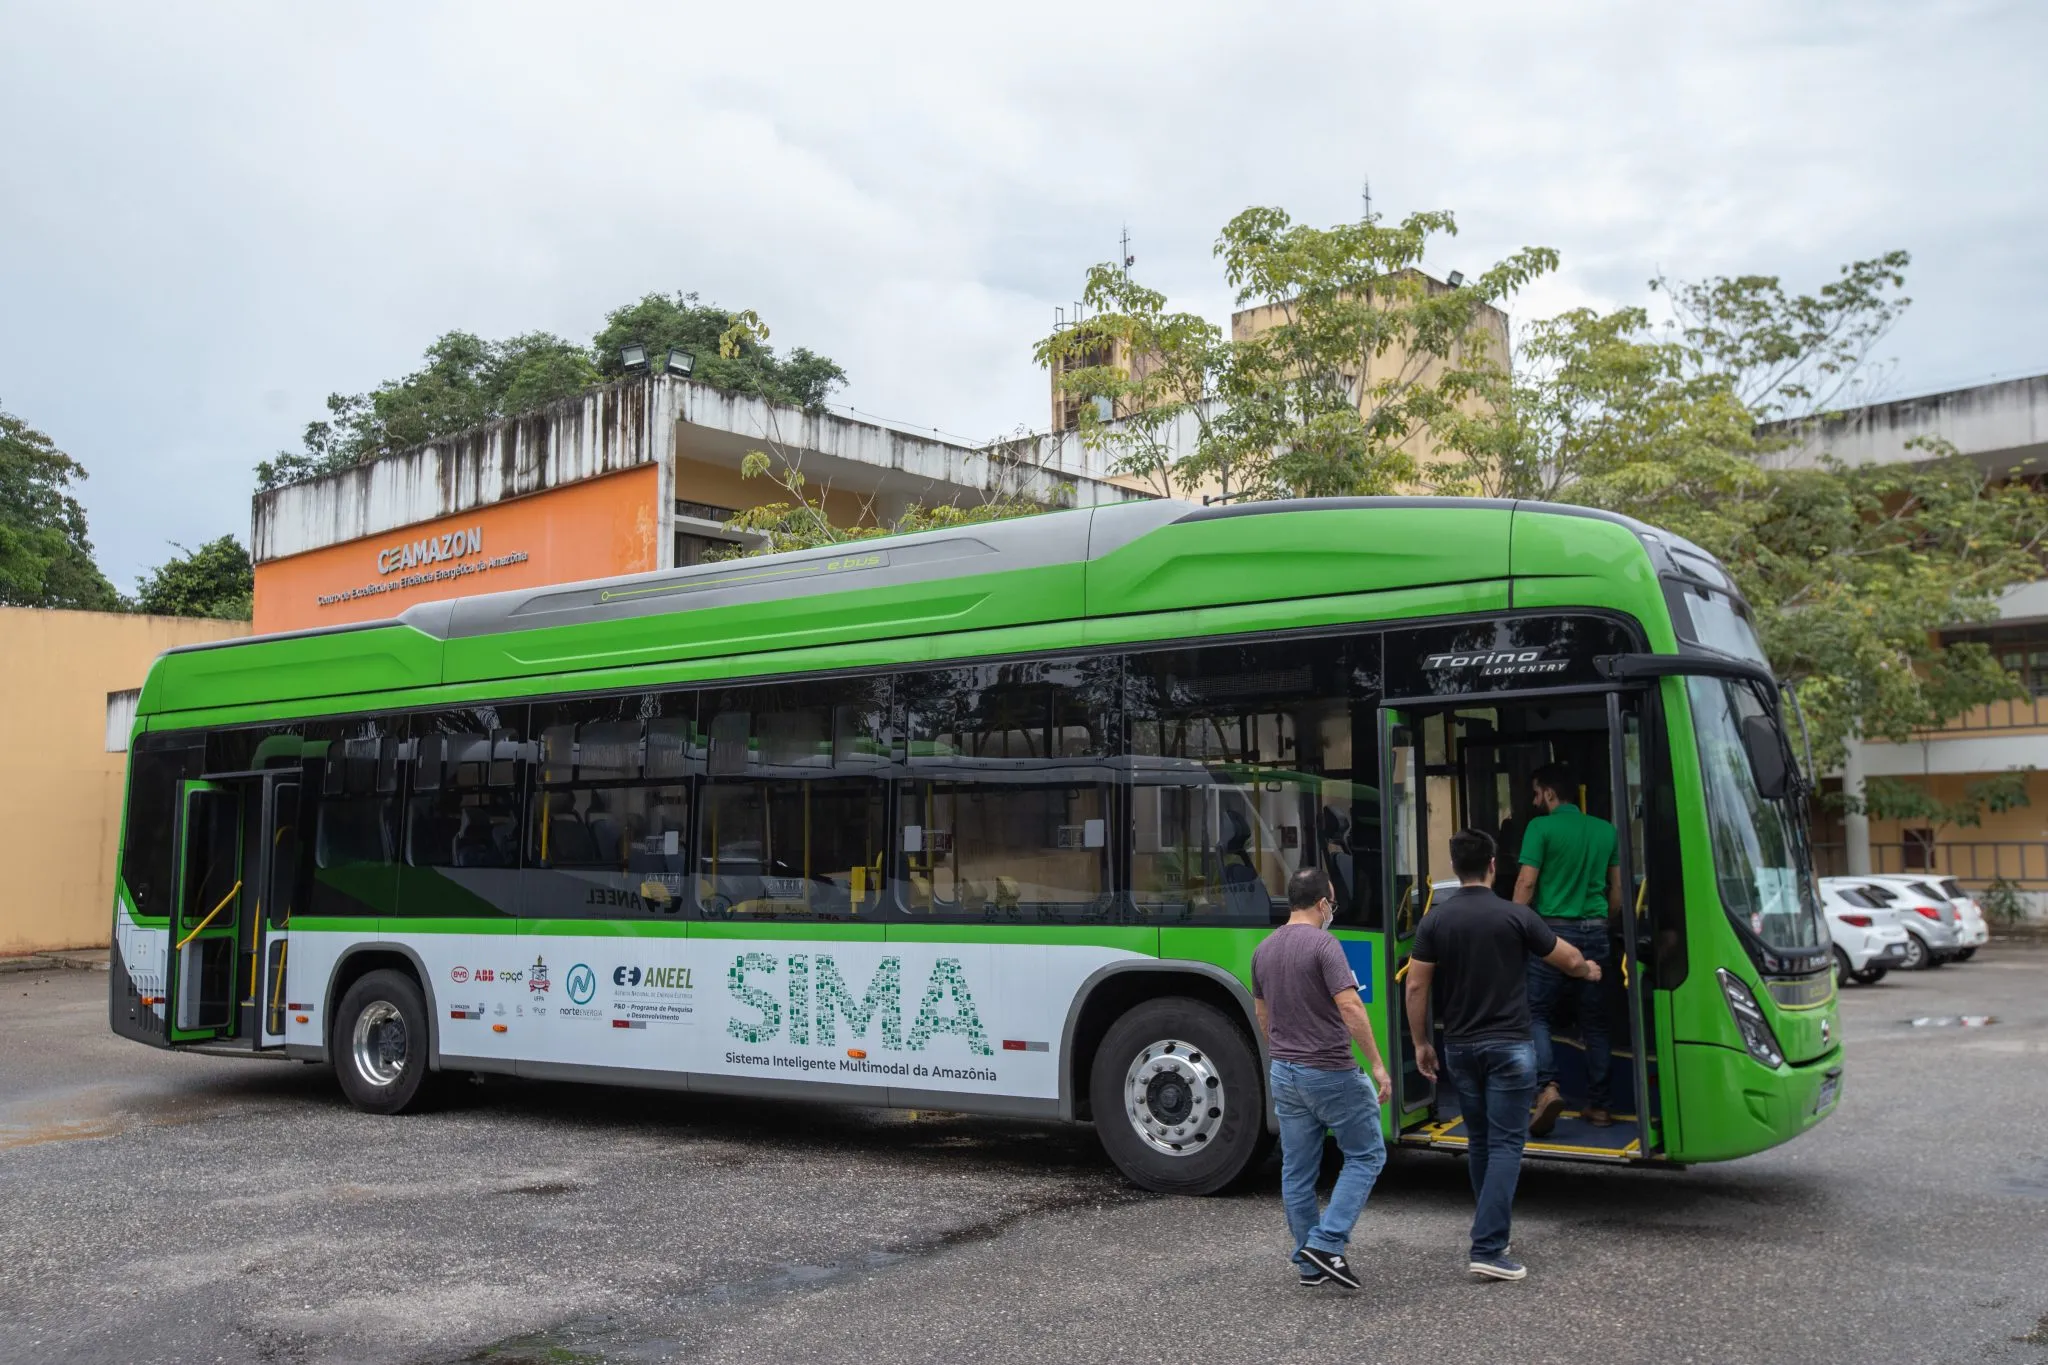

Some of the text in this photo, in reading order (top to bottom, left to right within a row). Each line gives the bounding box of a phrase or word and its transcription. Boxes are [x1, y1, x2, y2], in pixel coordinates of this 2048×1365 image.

[388, 581, 399, 591] em
[435, 564, 474, 583] Energética
[476, 562, 486, 571] da
[489, 551, 528, 569] Amazônia
[1429, 652, 1538, 668] Torino
[1485, 663, 1567, 676] LOW ENTRY
[474, 969, 494, 982] ABB
[644, 967, 693, 989] ANEEL
[631, 1004, 658, 1013] Programa
[668, 1005, 693, 1015] Pesquisa
[726, 951, 995, 1056] SIMA
[631, 1012, 680, 1021] Desenvolvimento
[725, 1052, 997, 1082] Sistema Inteligente Multimodal da Amazônia
